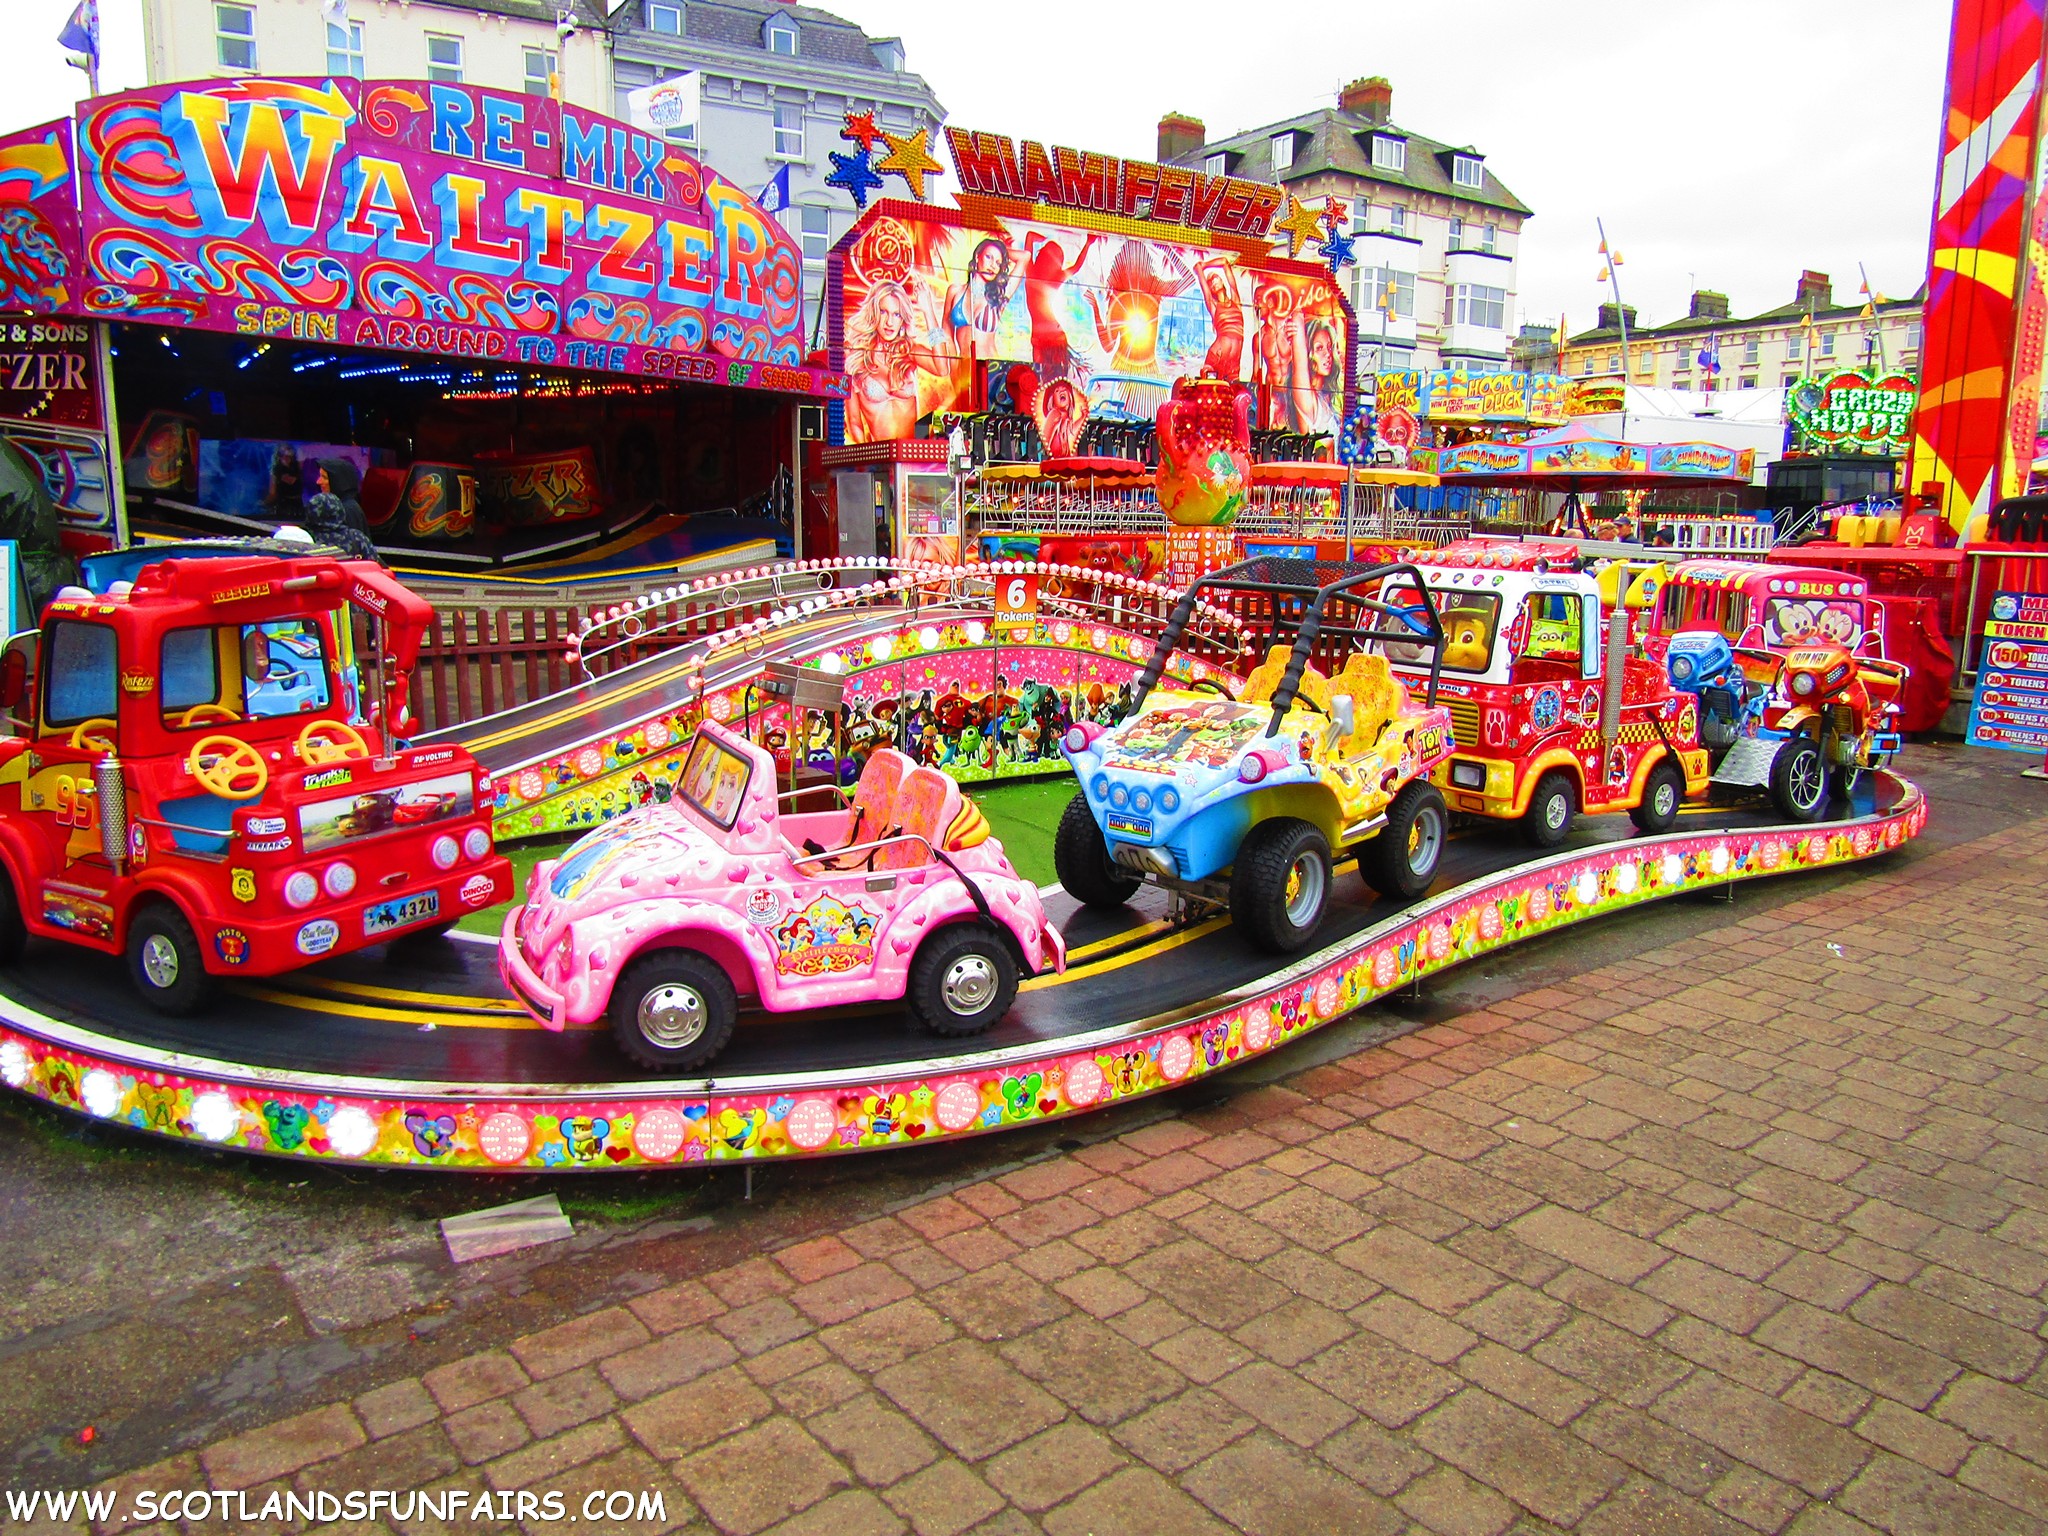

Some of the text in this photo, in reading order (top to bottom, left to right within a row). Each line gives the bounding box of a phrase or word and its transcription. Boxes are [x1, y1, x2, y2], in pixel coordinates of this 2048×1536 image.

[429, 83, 665, 202] RE-MIX
[944, 125, 1284, 238] MIAMI FEVER
[164, 90, 767, 316] WALTZER
[11, 324, 27, 343] &
[32, 324, 89, 343] SONS
[234, 302, 814, 392] SPIN AROUND TO THE SPEED OF SOUND
[1467, 373, 1526, 398] HOOK A
[1376, 387, 1418, 412] DUCK
[1482, 389, 1525, 414] DUCK
[1830, 387, 1914, 414] CRAZY
[1173, 540, 1198, 549] WARNING
[1216, 540, 1232, 556] CUP
[1172, 551, 1179, 561] DO
[1184, 563, 1196, 573] CUPS
[212, 583, 270, 604] RESCUE
[354, 583, 388, 610] No Stall
[1006, 578, 1027, 609] 6
[1798, 582, 1834, 596] BUS
[50, 603, 116, 614] PISTON CUP
[997, 611, 1035, 623] Tokens
[1994, 623, 2046, 638] TOKEN
[1994, 648, 2020, 663] 150
[1990, 675, 2046, 689] 20 TOKENS
[2006, 694, 2042, 705] TOKENS
[2003, 711, 2038, 722] TOKENS
[1419, 726, 1442, 751] TOY
[1980, 728, 1993, 737] 120
[2000, 730, 2035, 740] TOKENS
[1422, 747, 1440, 760] STORY
[55, 774, 94, 829] 95
[462, 882, 492, 898] DINOCO
[398, 896, 437, 919] 432U
[217, 928, 247, 943] PISTON
[301, 923, 335, 940] Blue Valley
[305, 936, 332, 948] GOODYEAR
[224, 954, 241, 964] CUP
[792, 946, 861, 963] Princesses
